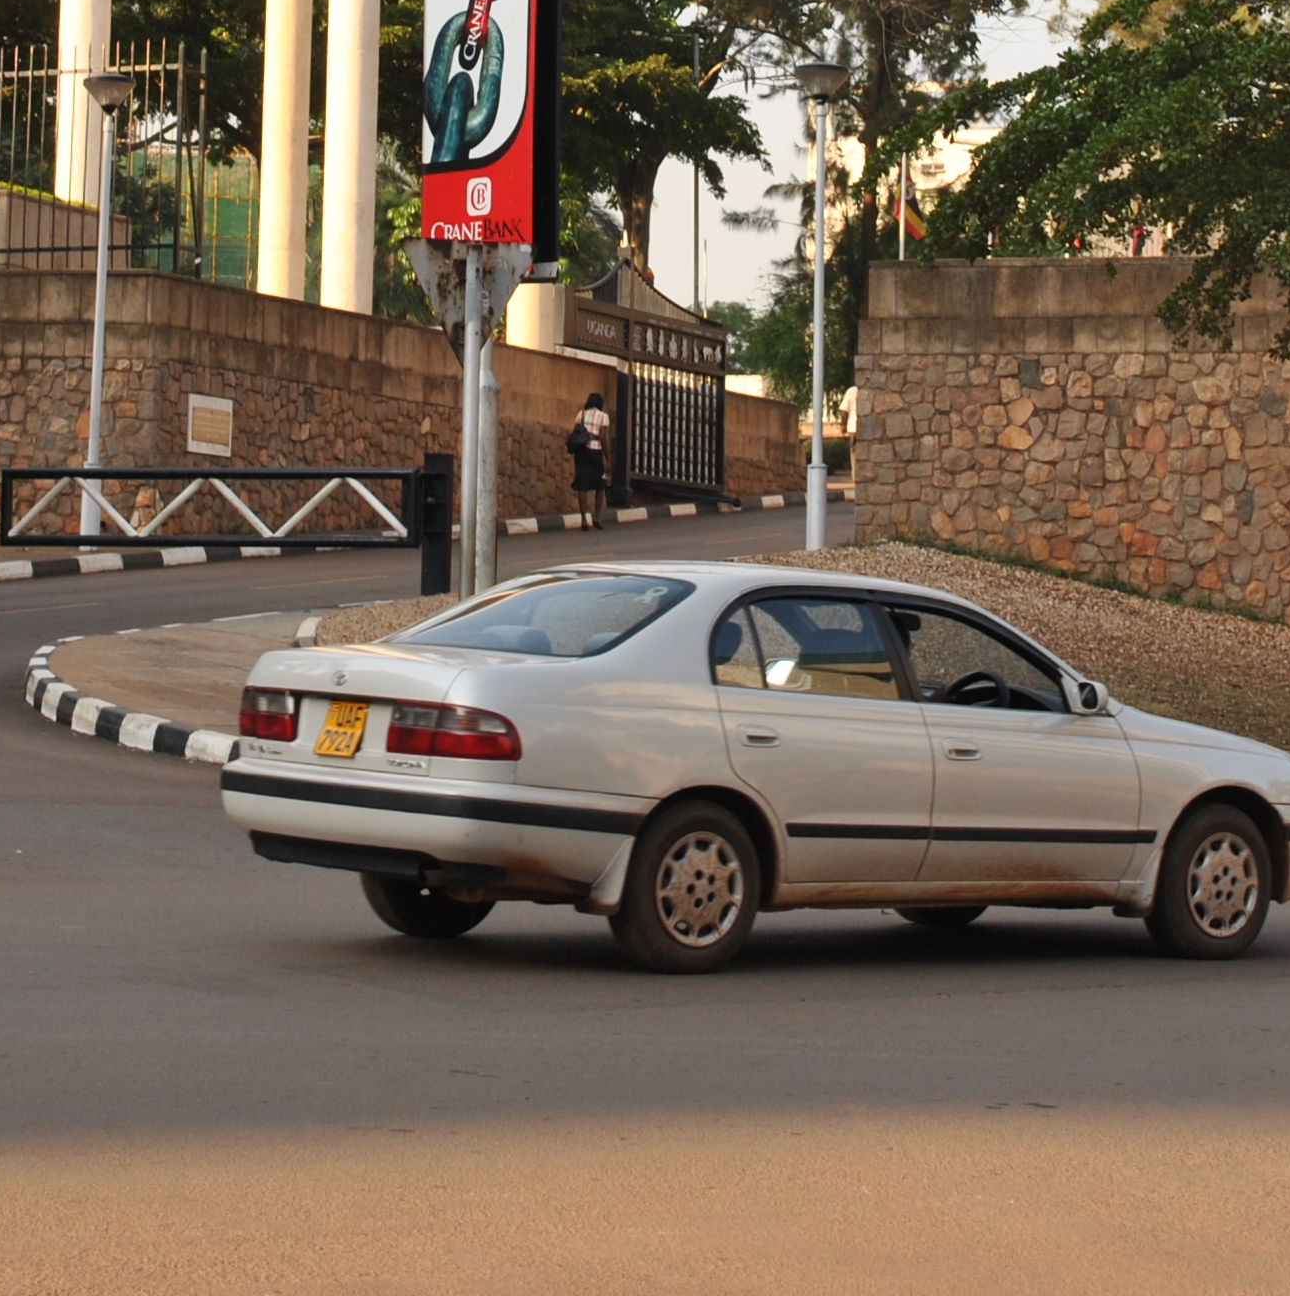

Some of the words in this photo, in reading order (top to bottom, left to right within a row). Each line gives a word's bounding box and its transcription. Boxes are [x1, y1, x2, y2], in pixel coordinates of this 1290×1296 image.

[586, 319, 616, 338] UGANDA
[337, 704, 364, 728] UAF
[318, 729, 356, 752] 792A
